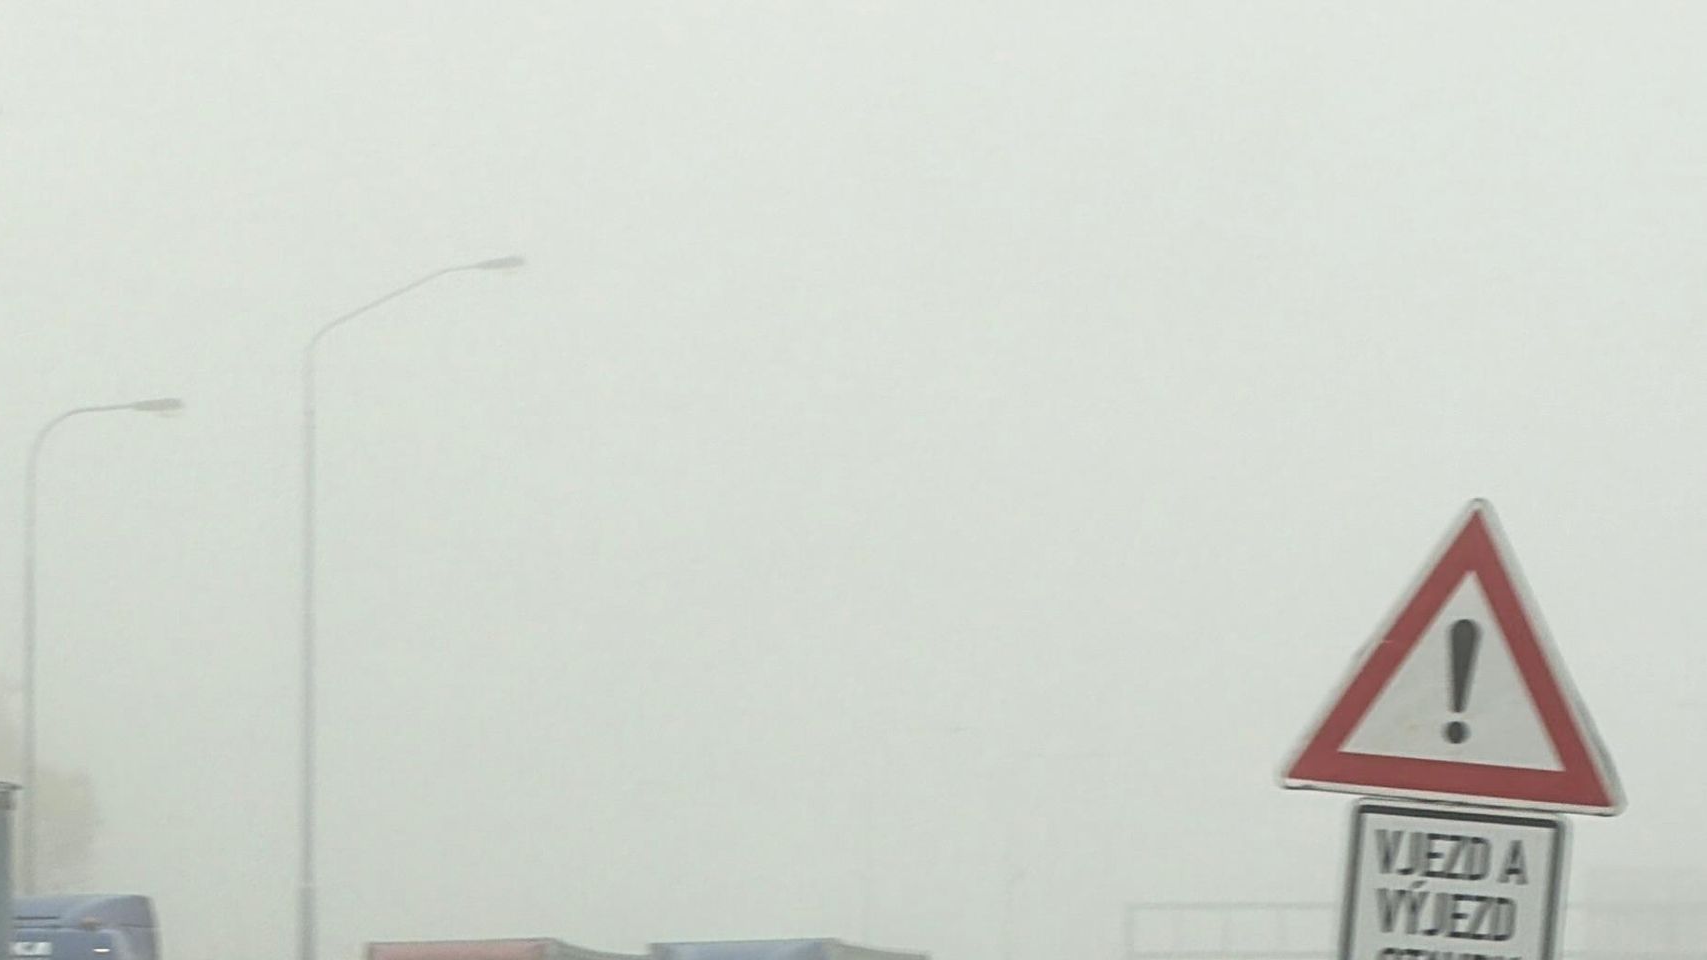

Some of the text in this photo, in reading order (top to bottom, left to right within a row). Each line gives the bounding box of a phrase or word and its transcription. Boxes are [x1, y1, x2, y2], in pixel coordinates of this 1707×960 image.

[1374, 829, 1529, 885] VJEZD A
[1374, 880, 1517, 941] VÝJEZD
